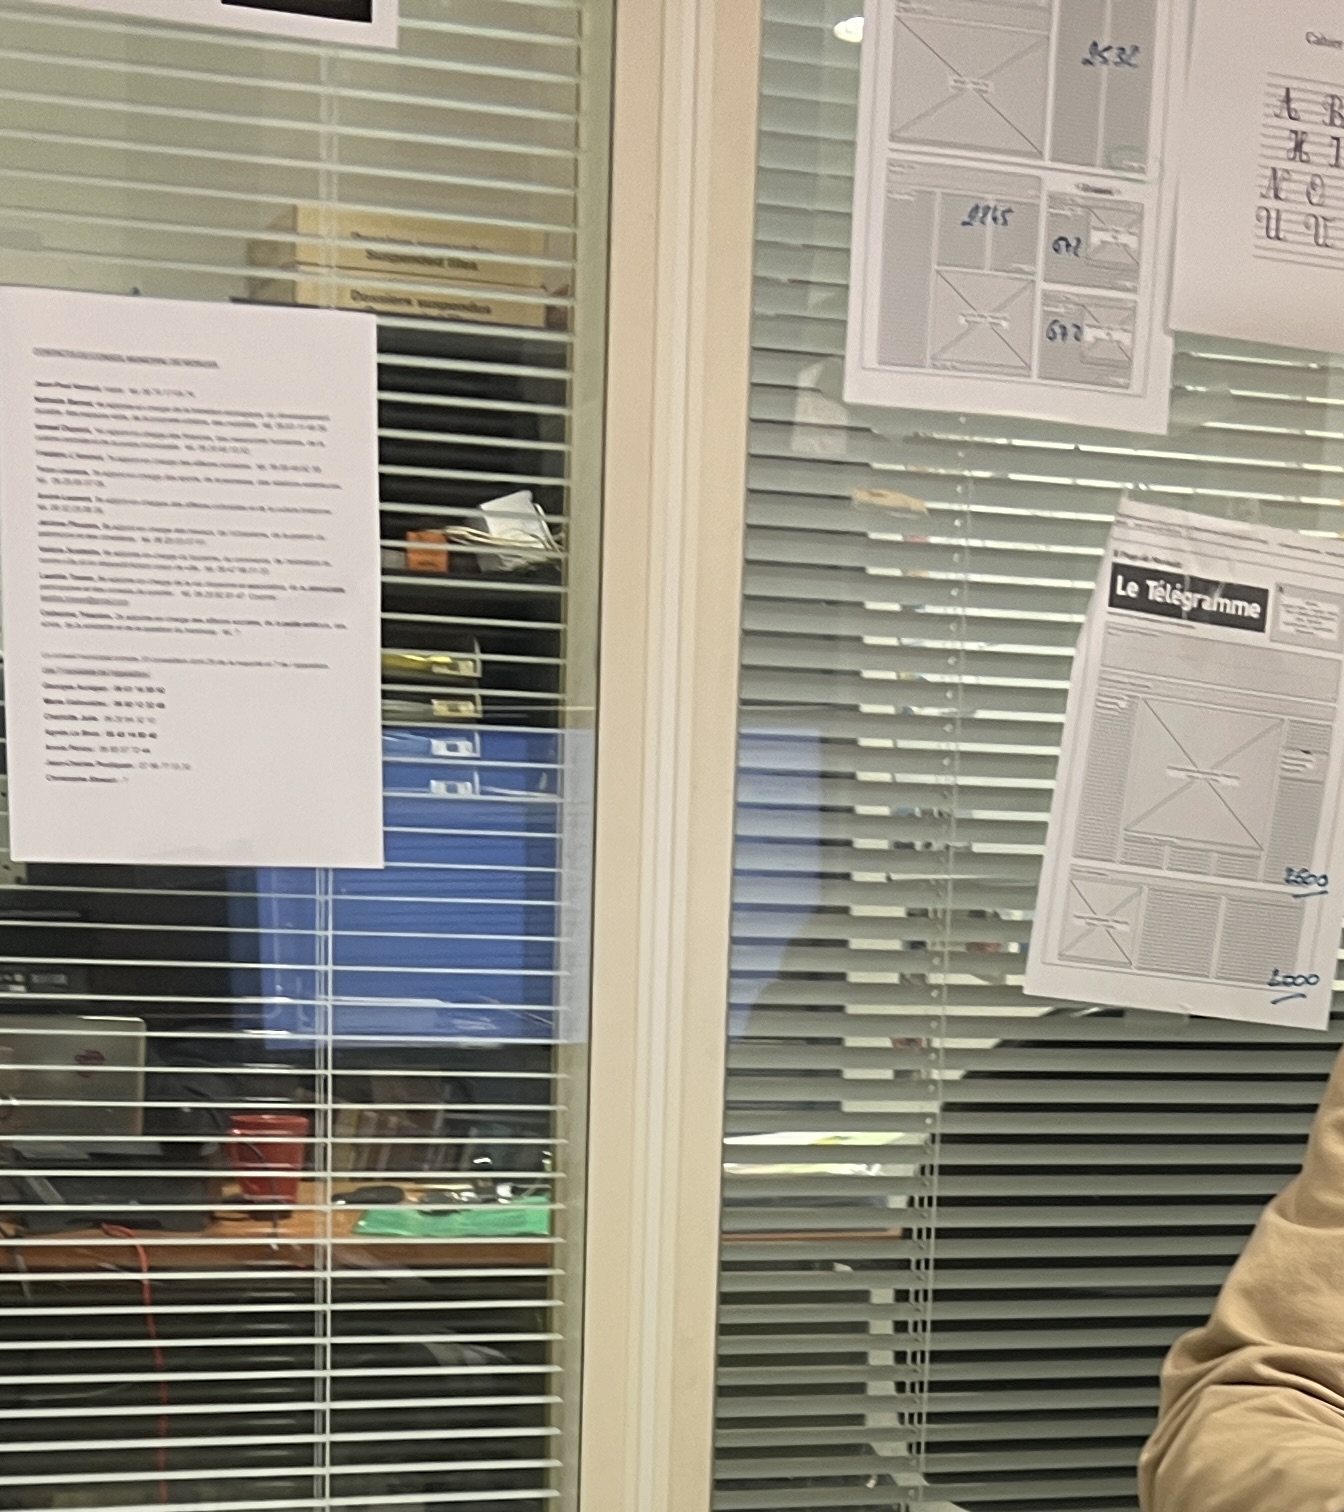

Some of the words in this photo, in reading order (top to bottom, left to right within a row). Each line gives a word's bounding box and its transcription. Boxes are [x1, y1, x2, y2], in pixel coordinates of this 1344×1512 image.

[1274, 88, 1300, 120] A
[1287, 130, 1310, 163] H
[1329, 136, 1341, 167] I
[1260, 167, 1290, 200] N
[1306, 174, 1325, 206] O
[1256, 206, 1285, 240] U
[1116, 574, 1140, 598] Le
[1145, 578, 1262, 619] Télégramme
